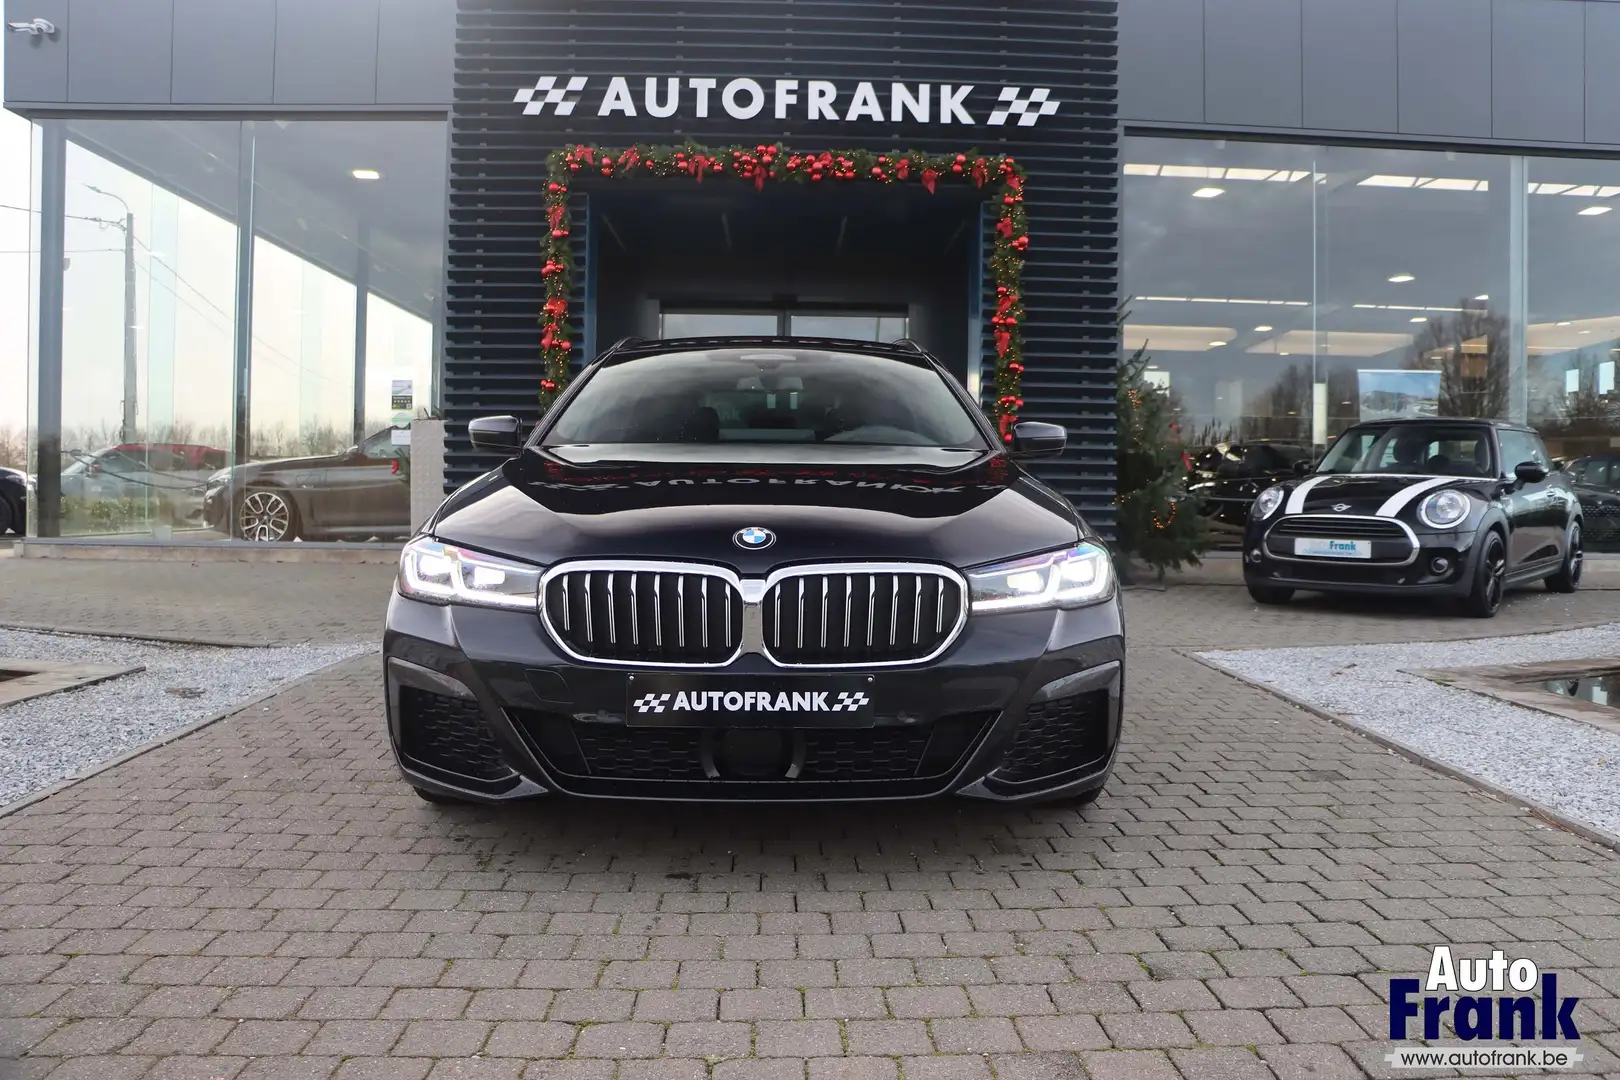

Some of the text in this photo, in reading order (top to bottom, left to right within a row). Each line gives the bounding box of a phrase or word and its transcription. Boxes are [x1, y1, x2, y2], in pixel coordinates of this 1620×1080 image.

[597, 76, 976, 125] AUTOFRANK
[1329, 540, 1356, 551] Frank
[672, 691, 831, 712] AUTOFRANK
